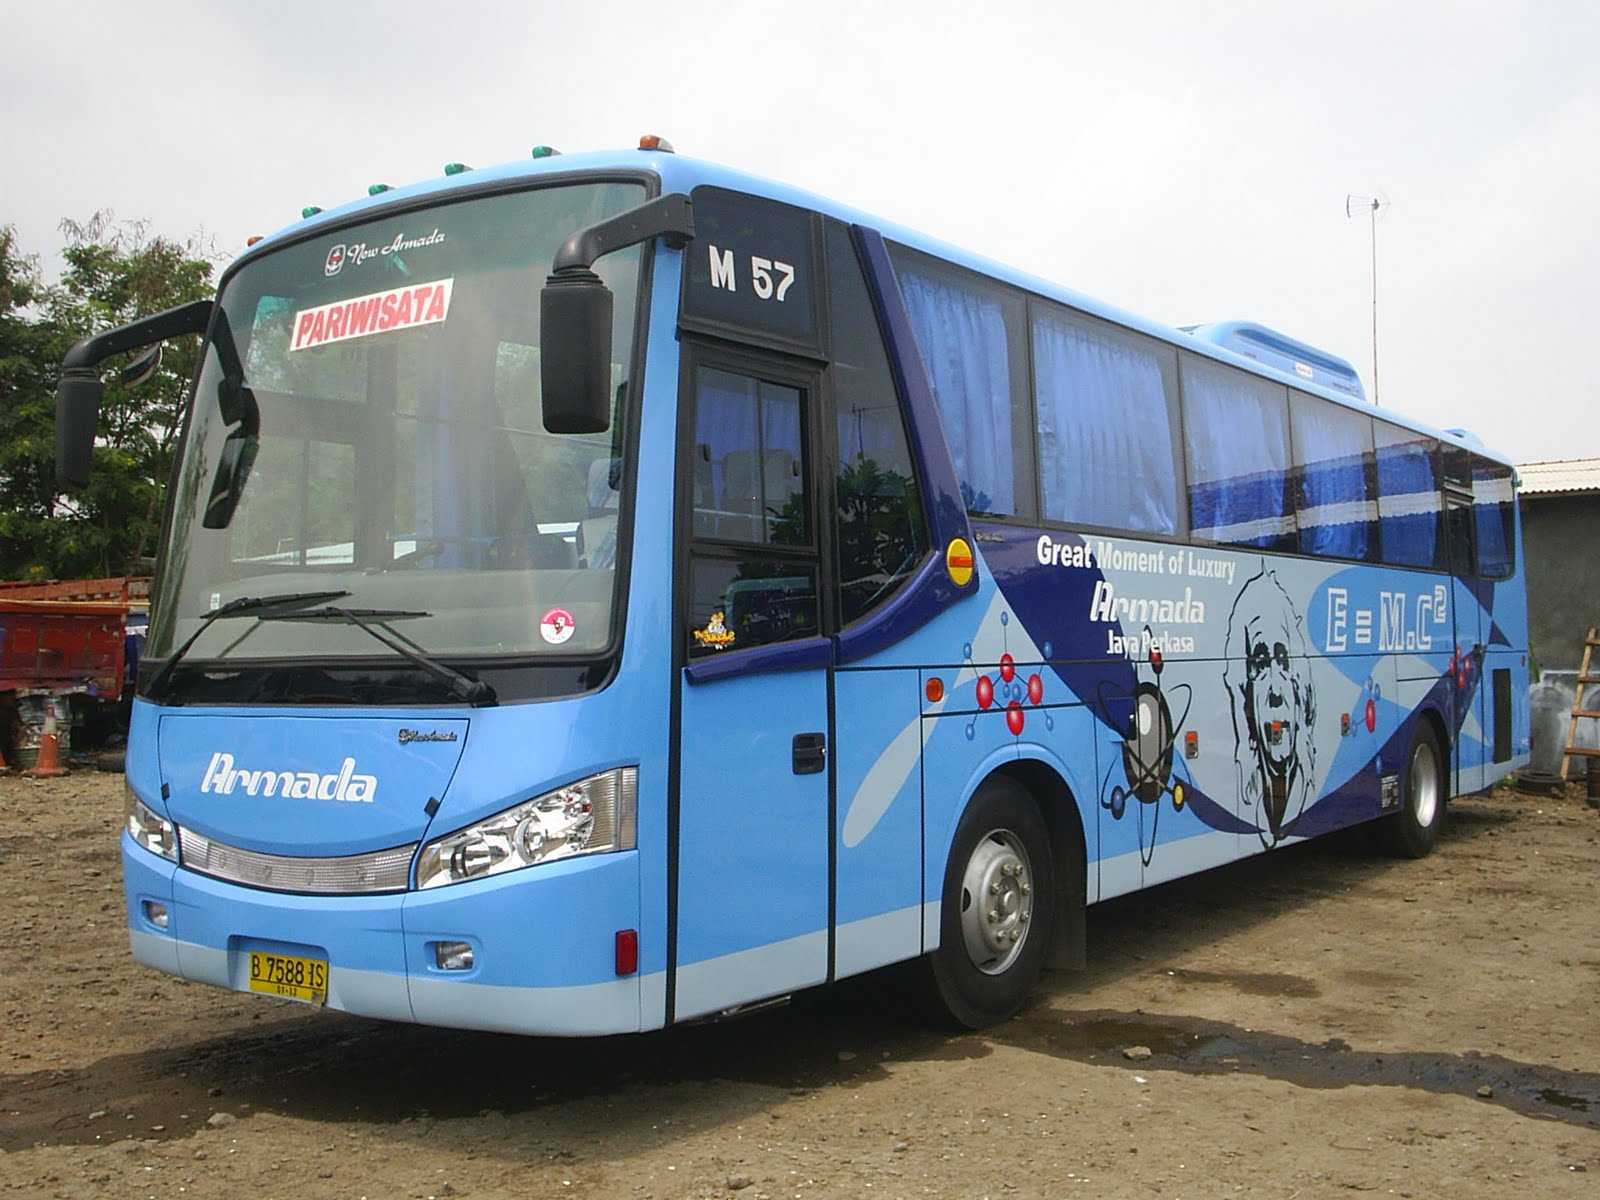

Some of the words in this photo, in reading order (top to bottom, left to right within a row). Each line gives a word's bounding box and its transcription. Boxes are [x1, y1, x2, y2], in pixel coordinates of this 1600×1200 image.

[347, 243, 379, 265] New
[381, 228, 446, 255] Armada
[708, 244, 736, 292] M
[751, 255, 795, 302] 57
[296, 284, 445, 348] PARIWISATA
[1037, 534, 1092, 569] Great
[1096, 540, 1165, 575] Moment
[1168, 549, 1185, 575] of
[1188, 550, 1236, 585] Luxury
[1089, 579, 1206, 624] Armada
[1106, 628, 1139, 660] Jaya
[1141, 627, 1195, 654] Perkasa
[201, 752, 378, 803] Armada
[252, 954, 260, 977] B
[266, 957, 304, 985] 7588
